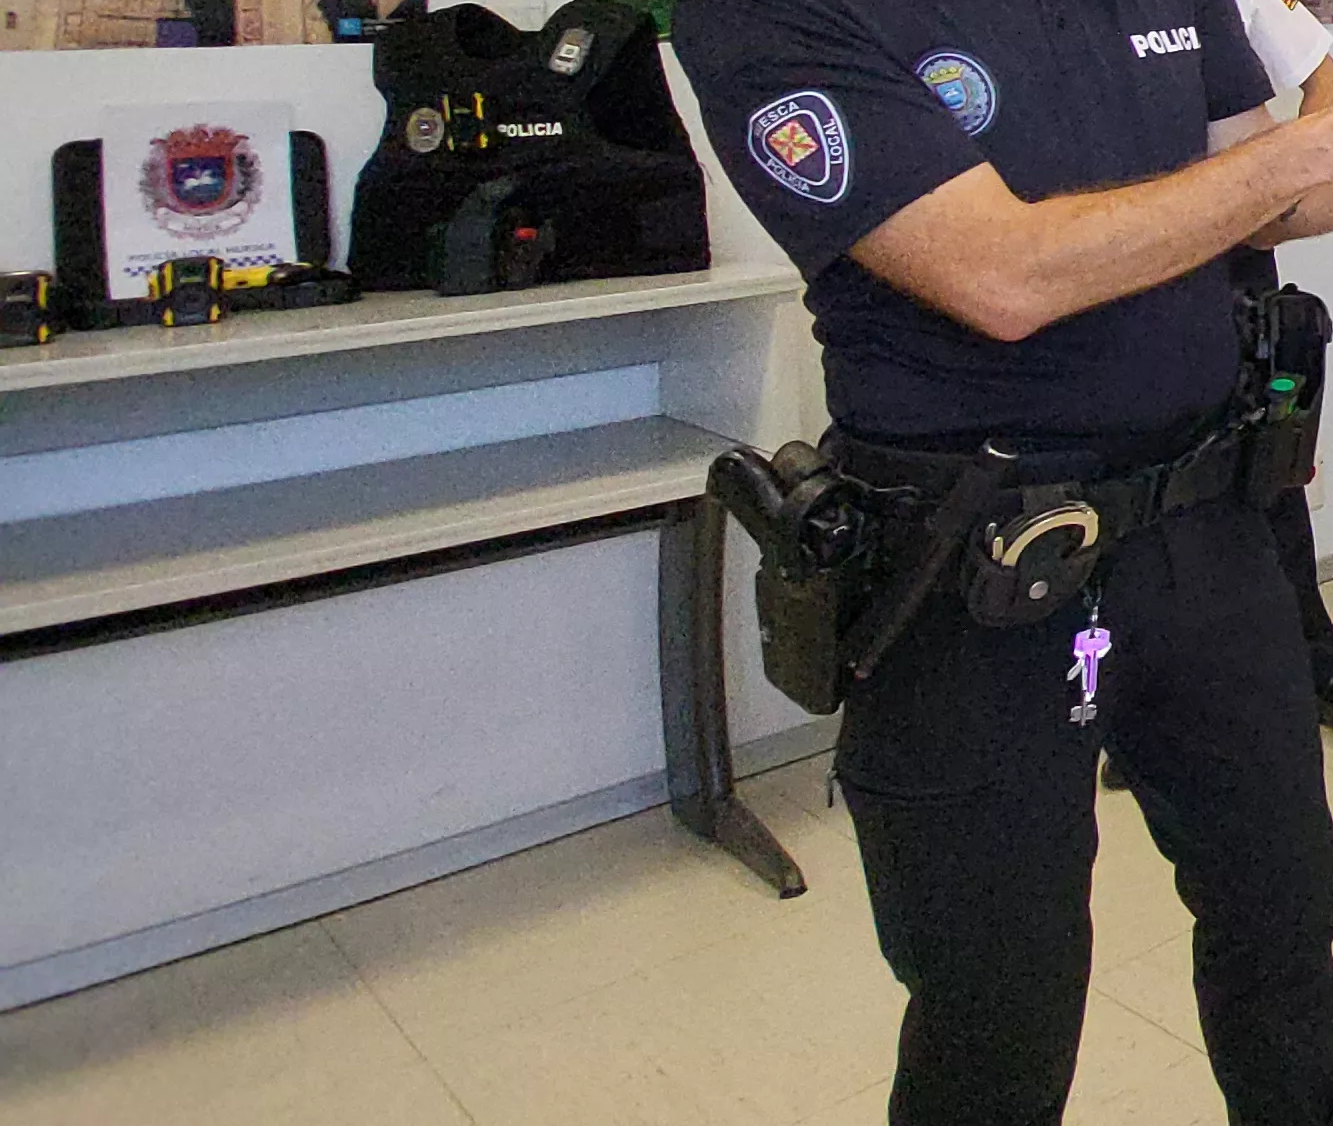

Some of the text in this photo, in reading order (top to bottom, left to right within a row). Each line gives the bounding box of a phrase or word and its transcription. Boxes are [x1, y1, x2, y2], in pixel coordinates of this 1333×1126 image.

[1129, 26, 1202, 58] POLICI
[496, 121, 563, 138] POLICIA
[822, 118, 844, 165] LOCAL
